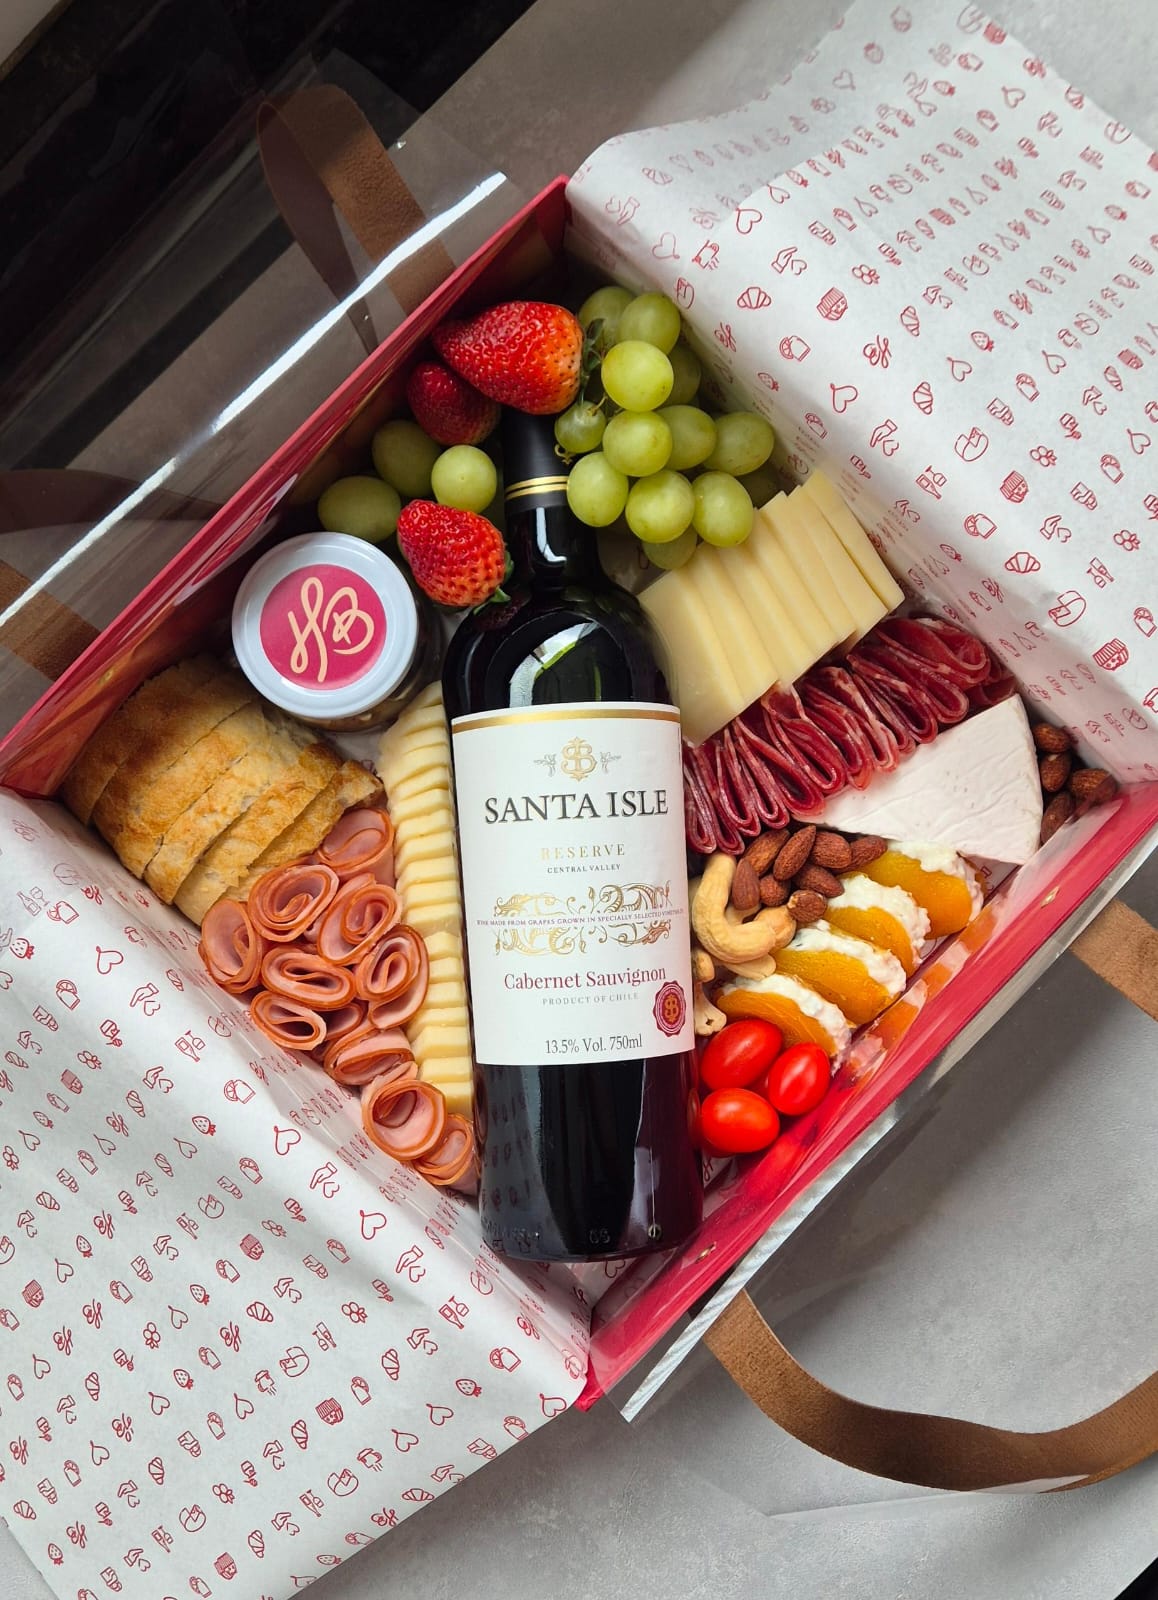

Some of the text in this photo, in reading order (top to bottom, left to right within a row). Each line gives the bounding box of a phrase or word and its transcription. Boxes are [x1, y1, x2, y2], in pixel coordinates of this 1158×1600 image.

[484, 789, 669, 825] SANTA ISLE
[541, 843, 626, 860] RESERVE
[547, 863, 622, 874] CENTRAL VALLEY
[528, 918, 555, 926] GRAPES
[557, 917, 586, 925] GROWN
[598, 913, 632, 922] SPECIALLY
[504, 967, 667, 990] Cabernet Sauvignon
[542, 992, 640, 1006] PRODUCT OF CHILE
[545, 1033, 643, 1054] 13.5% Vol. 750ml
